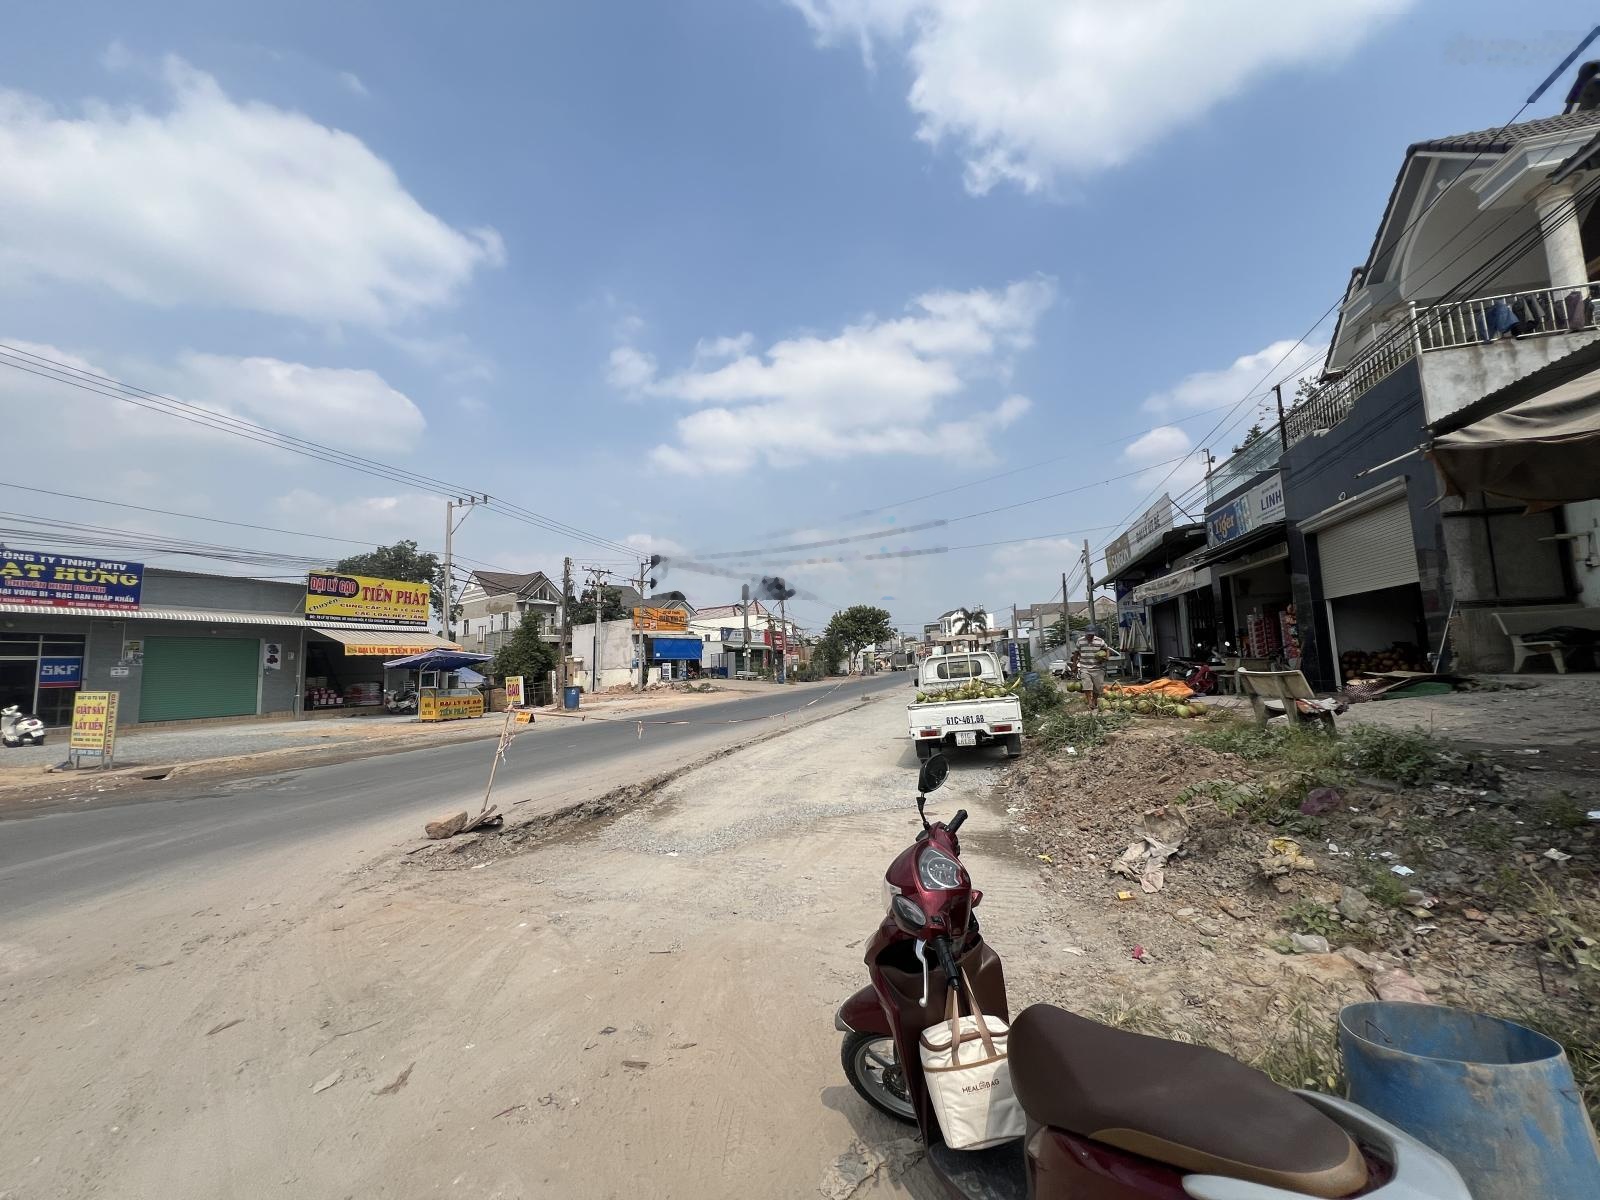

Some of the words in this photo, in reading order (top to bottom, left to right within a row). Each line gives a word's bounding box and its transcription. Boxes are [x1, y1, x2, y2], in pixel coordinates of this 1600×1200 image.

[1261, 490, 1282, 512] LINH
[1213, 512, 1235, 538] Tiger
[41, 554, 56, 563] TY
[60, 558, 96, 568] TNHH
[100, 562, 127, 570] MTV
[55, 567, 139, 585] HƯNG
[326, 577, 339, 593] LÝ
[338, 580, 357, 597] GẠO
[361, 582, 392, 602] TIẾN
[395, 588, 429, 606] PHÁT
[369, 646, 377, 654] LÝ
[389, 645, 408, 655] TIẾN
[41, 665, 79, 676] SKF
